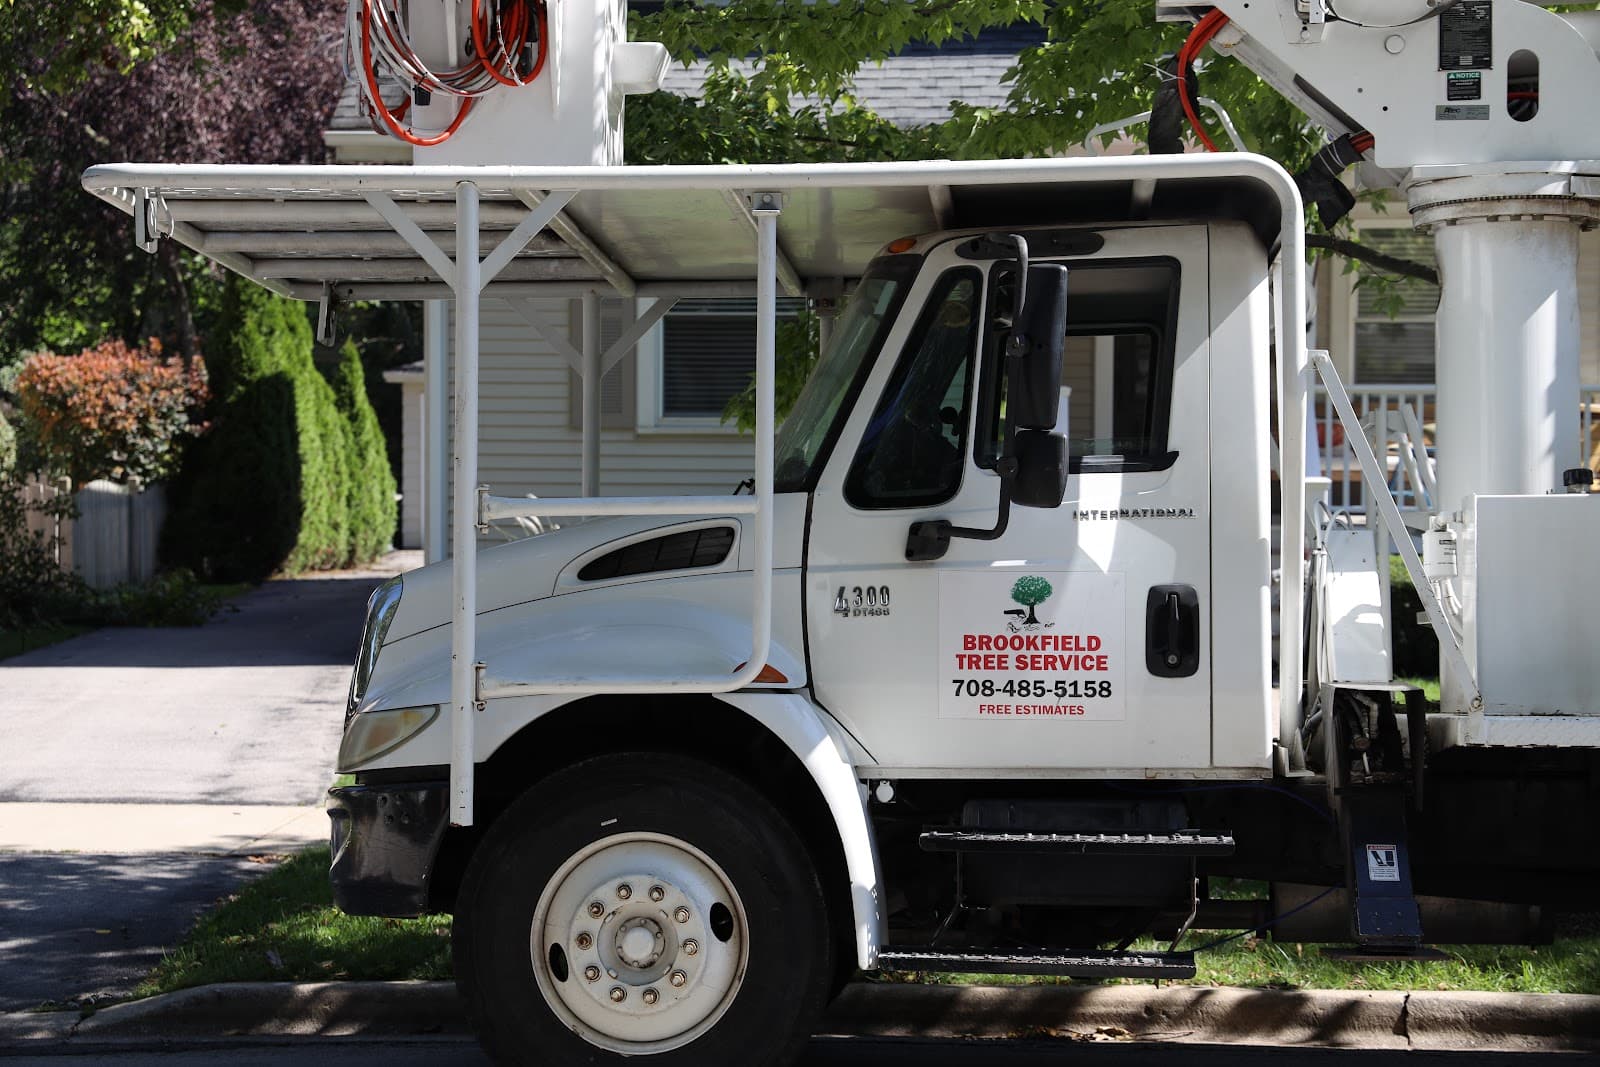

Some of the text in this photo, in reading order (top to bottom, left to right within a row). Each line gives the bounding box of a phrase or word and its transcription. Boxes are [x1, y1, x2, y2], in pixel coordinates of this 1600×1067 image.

[1073, 508, 1196, 520] INTERNATIONAL
[834, 586, 890, 617] 4300
[963, 634, 1101, 651] BROOKFIELD
[955, 654, 1109, 671] TREE SERVICE
[952, 679, 1112, 698] 708-485-5158
[979, 704, 1085, 715] FREE ESTIMATES
